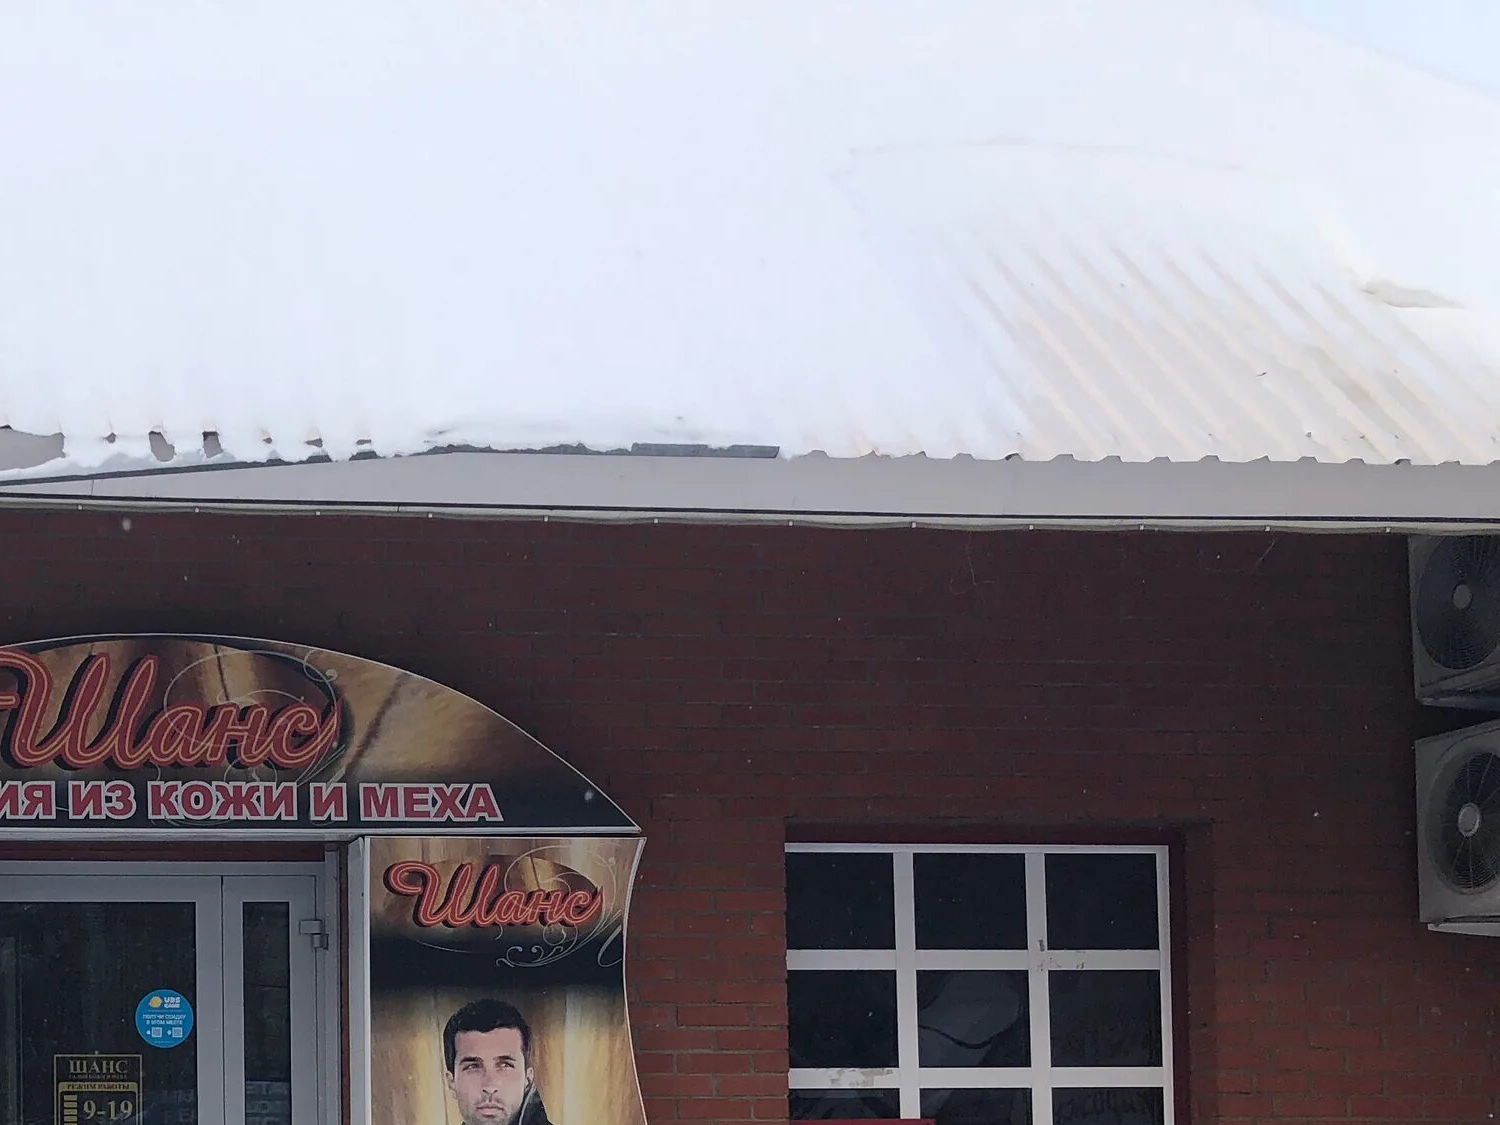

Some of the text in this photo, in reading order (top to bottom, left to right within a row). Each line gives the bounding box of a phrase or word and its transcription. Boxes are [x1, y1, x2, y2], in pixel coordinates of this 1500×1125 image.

[68, 780, 137, 820] ИЗ
[148, 780, 298, 821] КОЖИ
[310, 782, 348, 821] И
[359, 783, 504, 822] МЕХА
[386, 860, 604, 929] Шанс
[69, 1060, 128, 1074] ШАНС
[83, 1100, 133, 1120] 9-19
